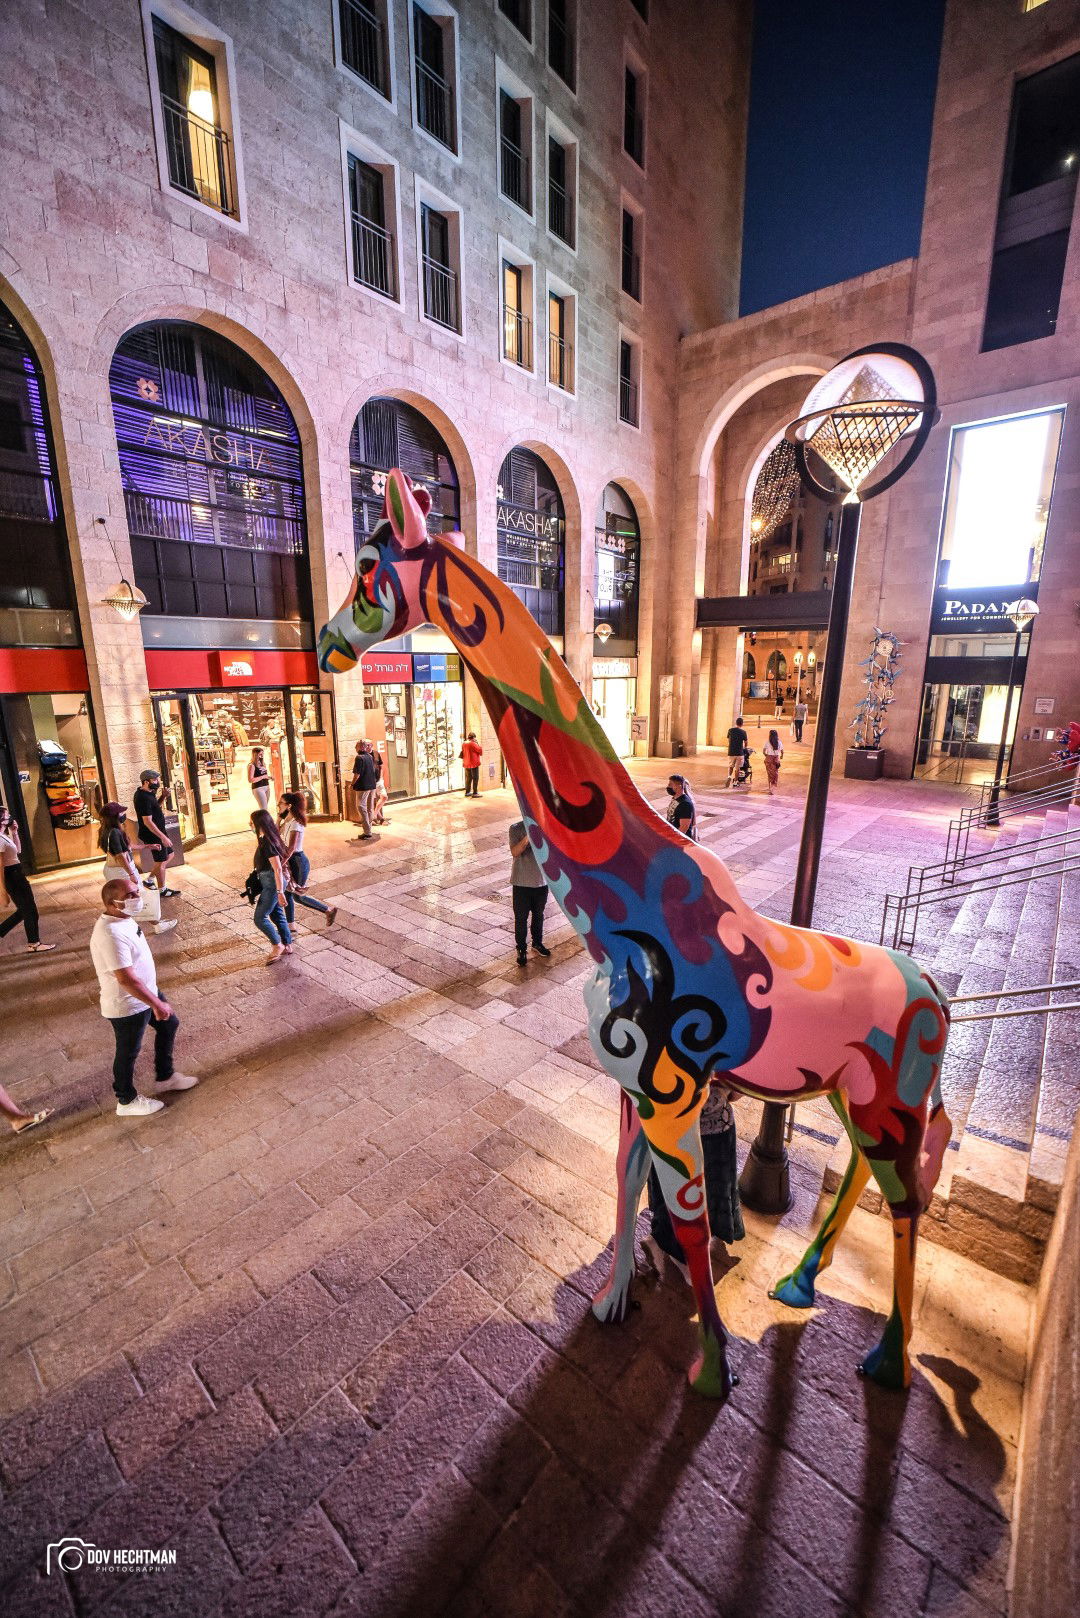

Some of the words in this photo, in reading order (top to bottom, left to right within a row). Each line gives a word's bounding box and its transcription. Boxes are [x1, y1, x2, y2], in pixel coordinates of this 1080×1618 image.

[144, 418, 275, 472] AKASHA
[497, 506, 553, 537] AKASHA
[943, 600, 1014, 614] PADAN
